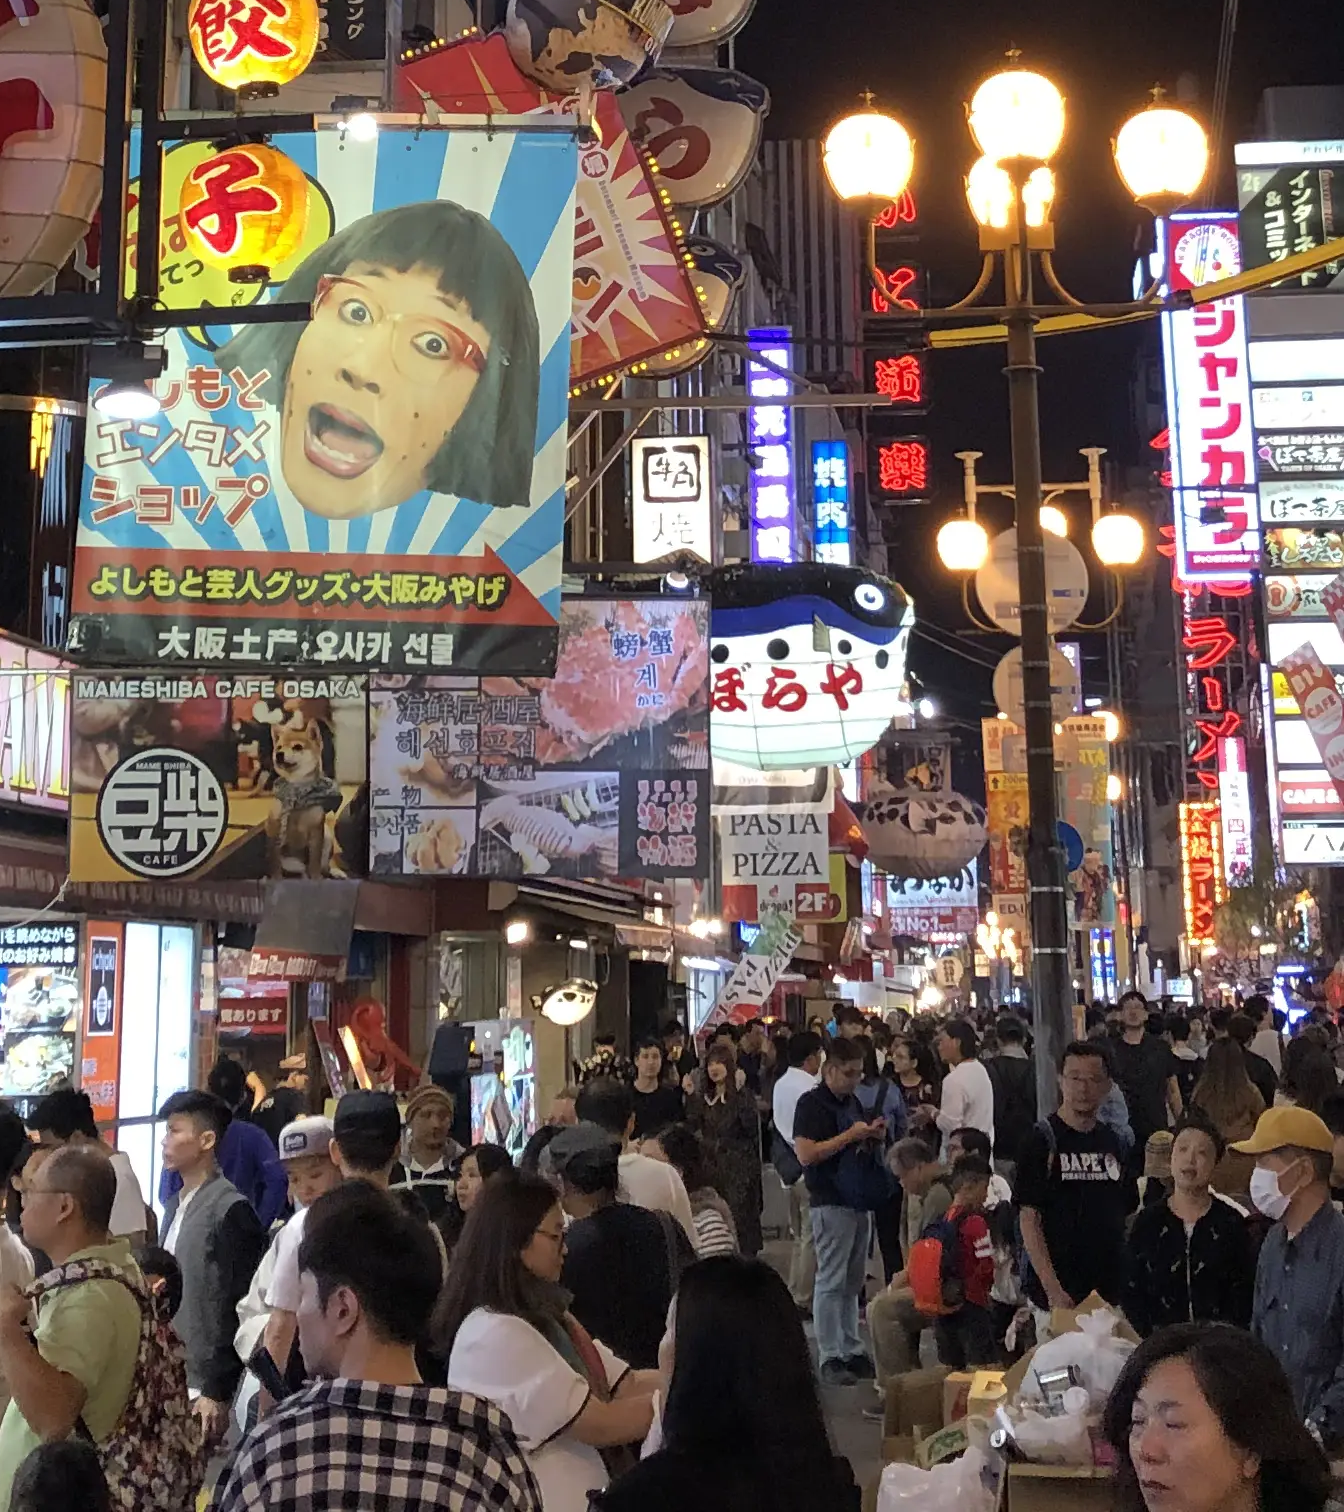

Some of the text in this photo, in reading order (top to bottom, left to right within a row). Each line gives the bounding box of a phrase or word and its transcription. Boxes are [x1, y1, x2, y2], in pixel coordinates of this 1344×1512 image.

[1242, 173, 1261, 192] 2F
[1289, 170, 1318, 286] インターネト
[95, 364, 271, 413] しもと
[1194, 298, 1249, 545] ジャンカラ
[96, 419, 271, 469] エンタメ
[89, 474, 270, 527] ショップ
[90, 566, 505, 607] よしもと芸人グッズ・大阪みやげ
[404, 629, 454, 665] 선물
[78, 681, 359, 698] MAMESHIBA CAFE OSAKA
[637, 694, 664, 707] かに
[1307, 693, 1337, 718] CAFE
[729, 814, 822, 836] PASTA
[143, 854, 178, 865] CAFE
[733, 852, 822, 877] PIZZA
[798, 892, 827, 912] 2F
[1060, 1153, 1103, 1171] BAPE
